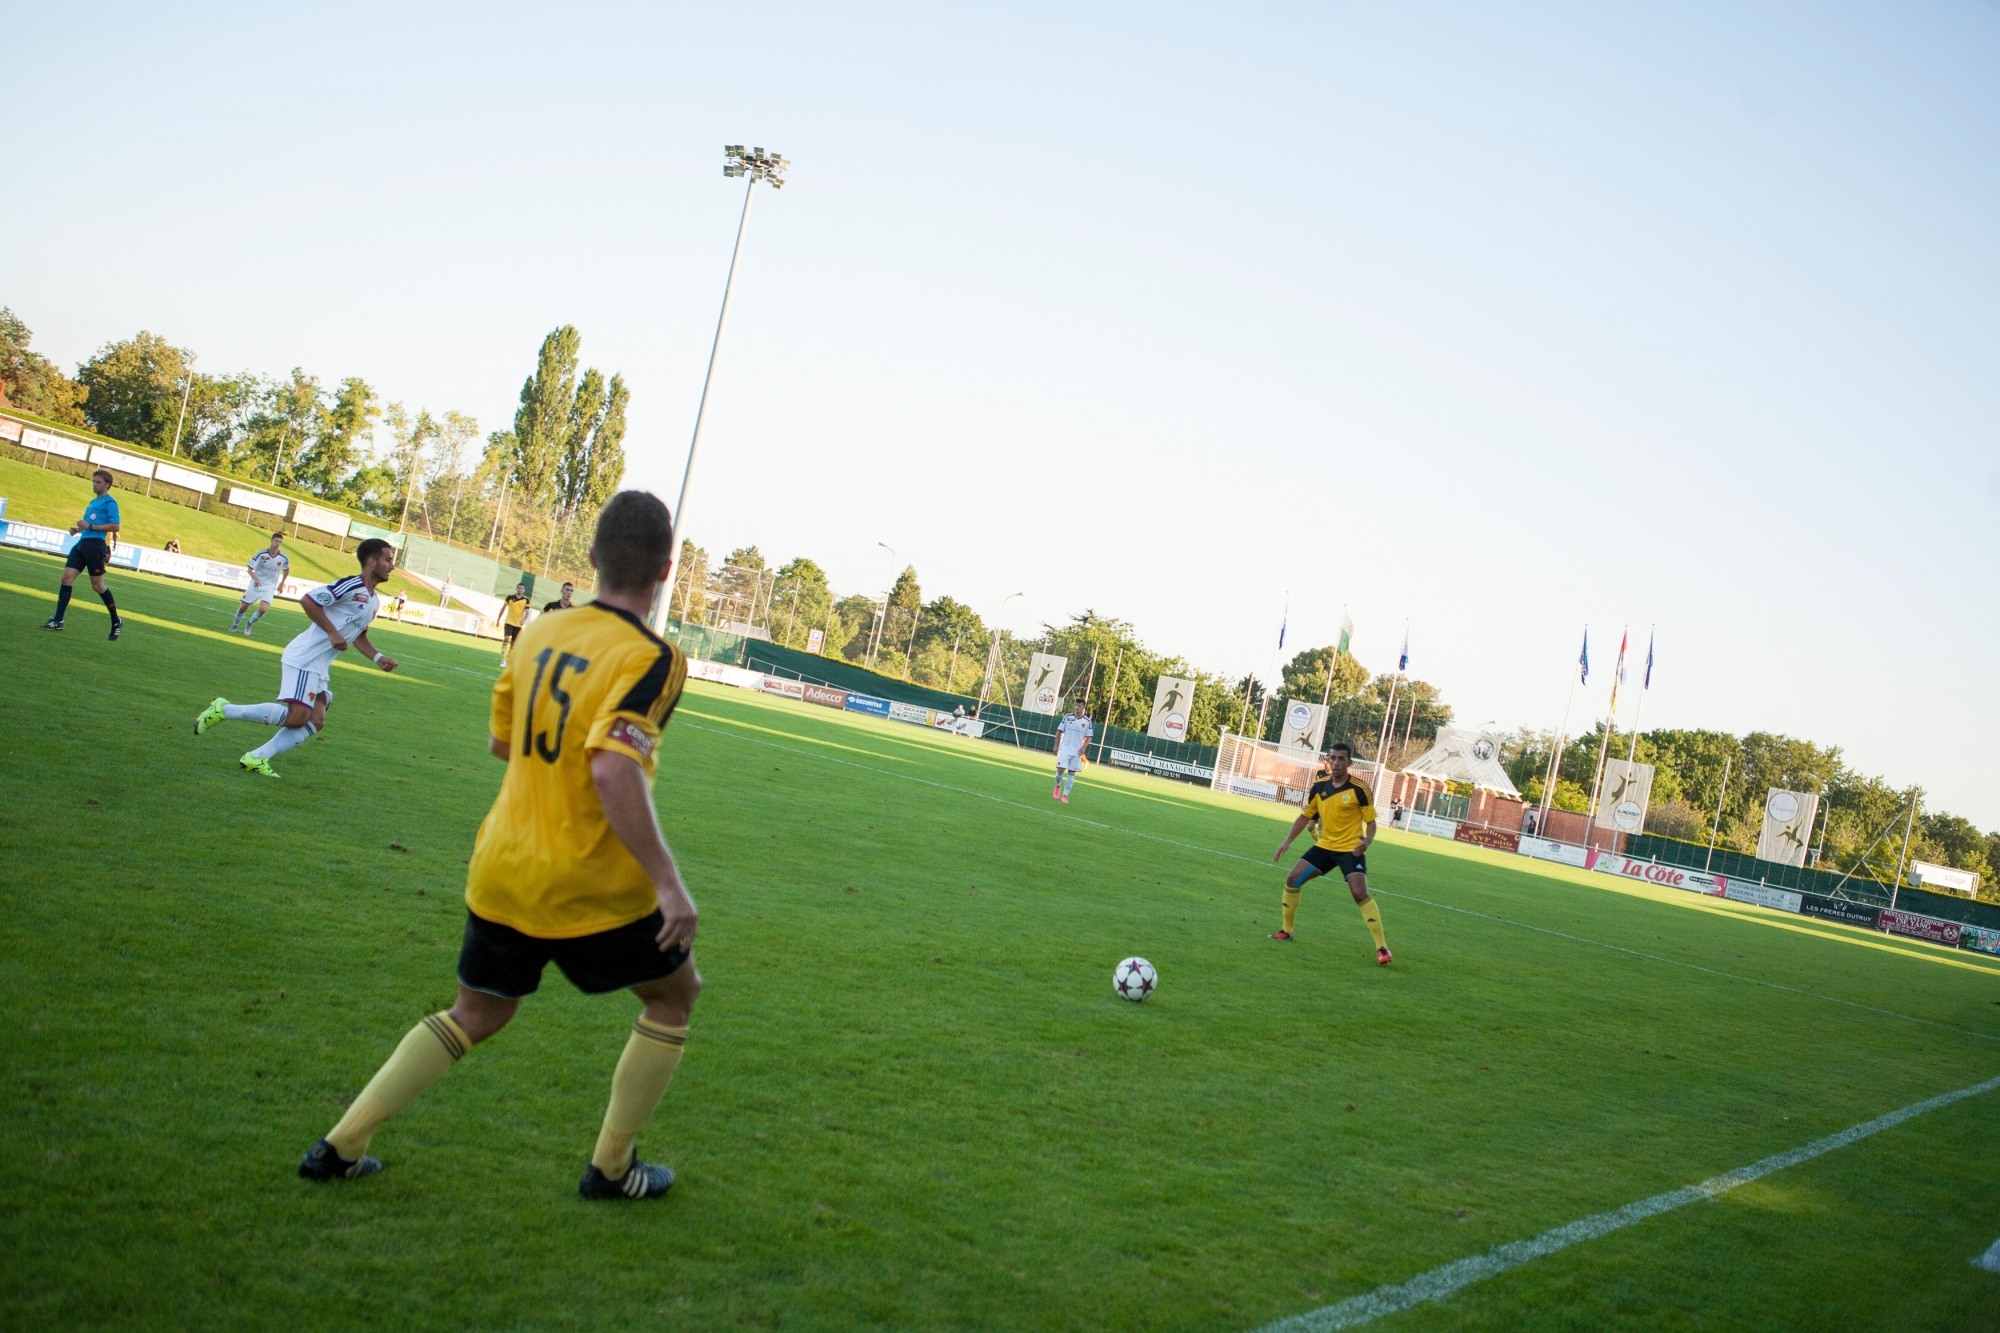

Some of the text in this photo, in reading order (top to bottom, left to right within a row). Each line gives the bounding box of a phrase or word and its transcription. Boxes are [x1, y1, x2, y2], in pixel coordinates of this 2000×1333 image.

[6, 523, 65, 546] INDUNI
[806, 687, 843, 704] Adecco
[522, 647, 590, 766] 15
[855, 698, 883, 709] SECURITAS
[903, 706, 927, 714] GARAGE
[1113, 751, 1136, 762] VISION
[1137, 756, 1157, 767] ASSET
[1159, 761, 1206, 777] MANAGEMENT
[1563, 848, 1586, 857] SCHMID
[1620, 859, 1643, 877] La
[1644, 864, 1685, 886] Côte
[1944, 873, 1966, 885] Village
[1728, 888, 1755, 898] PIZZERIA
[1729, 882, 1769, 894] RESTAURANT
[1846, 912, 1872, 922] DUTRUY
[1884, 910, 1922, 923] RESTAURANT
[1921, 917, 1945, 928] CHINOIS
[1910, 920, 1931, 931] YANG
